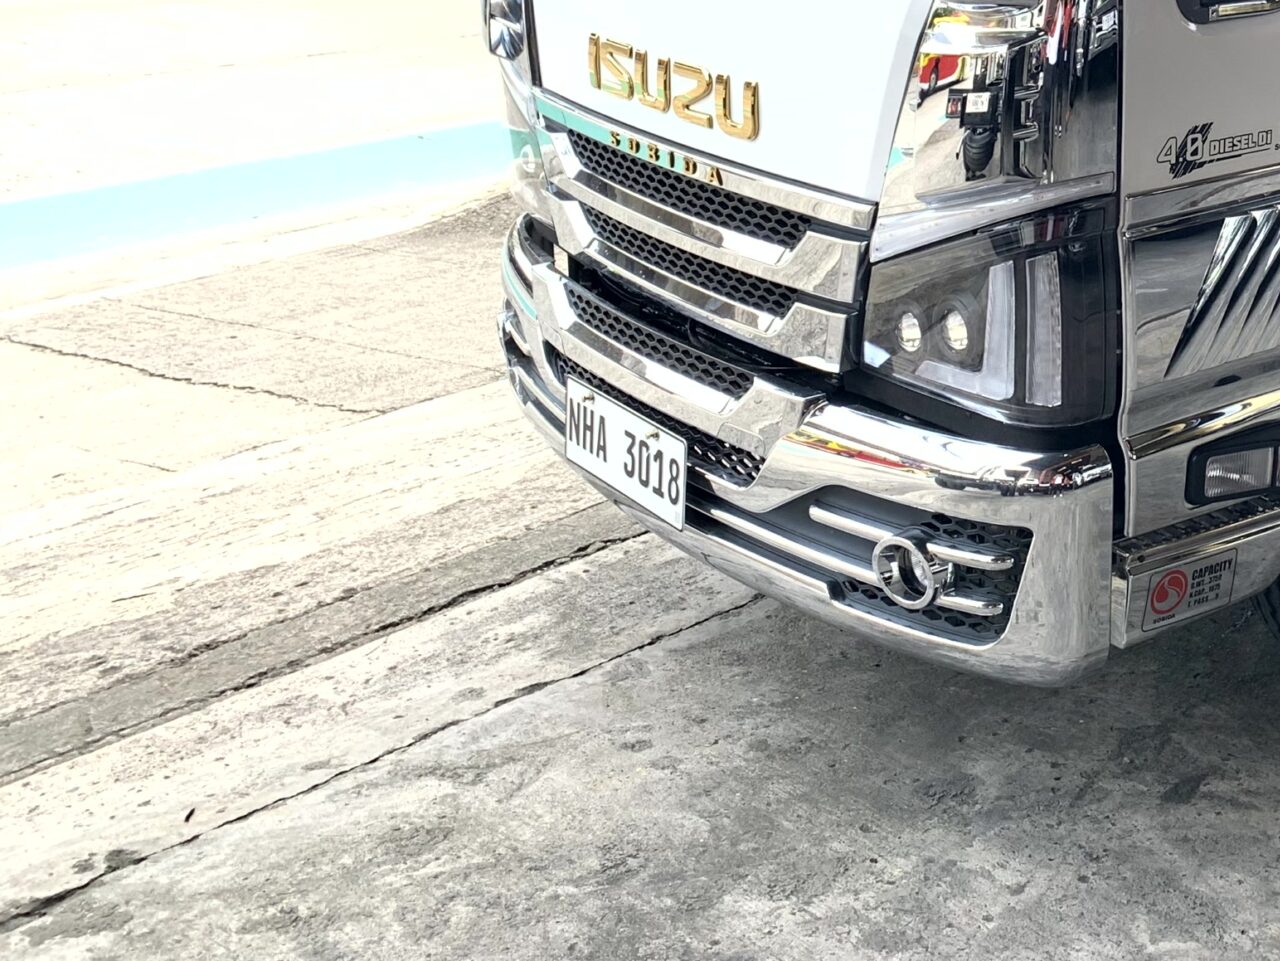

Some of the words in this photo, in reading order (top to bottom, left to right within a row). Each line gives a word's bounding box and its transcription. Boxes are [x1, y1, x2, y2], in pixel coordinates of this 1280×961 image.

[588, 33, 761, 141] ISUZU
[609, 130, 723, 186] SOBIDA
[1156, 133, 1204, 164] 4.0
[1209, 133, 1257, 157] DIESEL
[569, 397, 607, 463] NHA
[623, 429, 680, 506] 3018
[1192, 559, 1234, 581] CAPACITY
